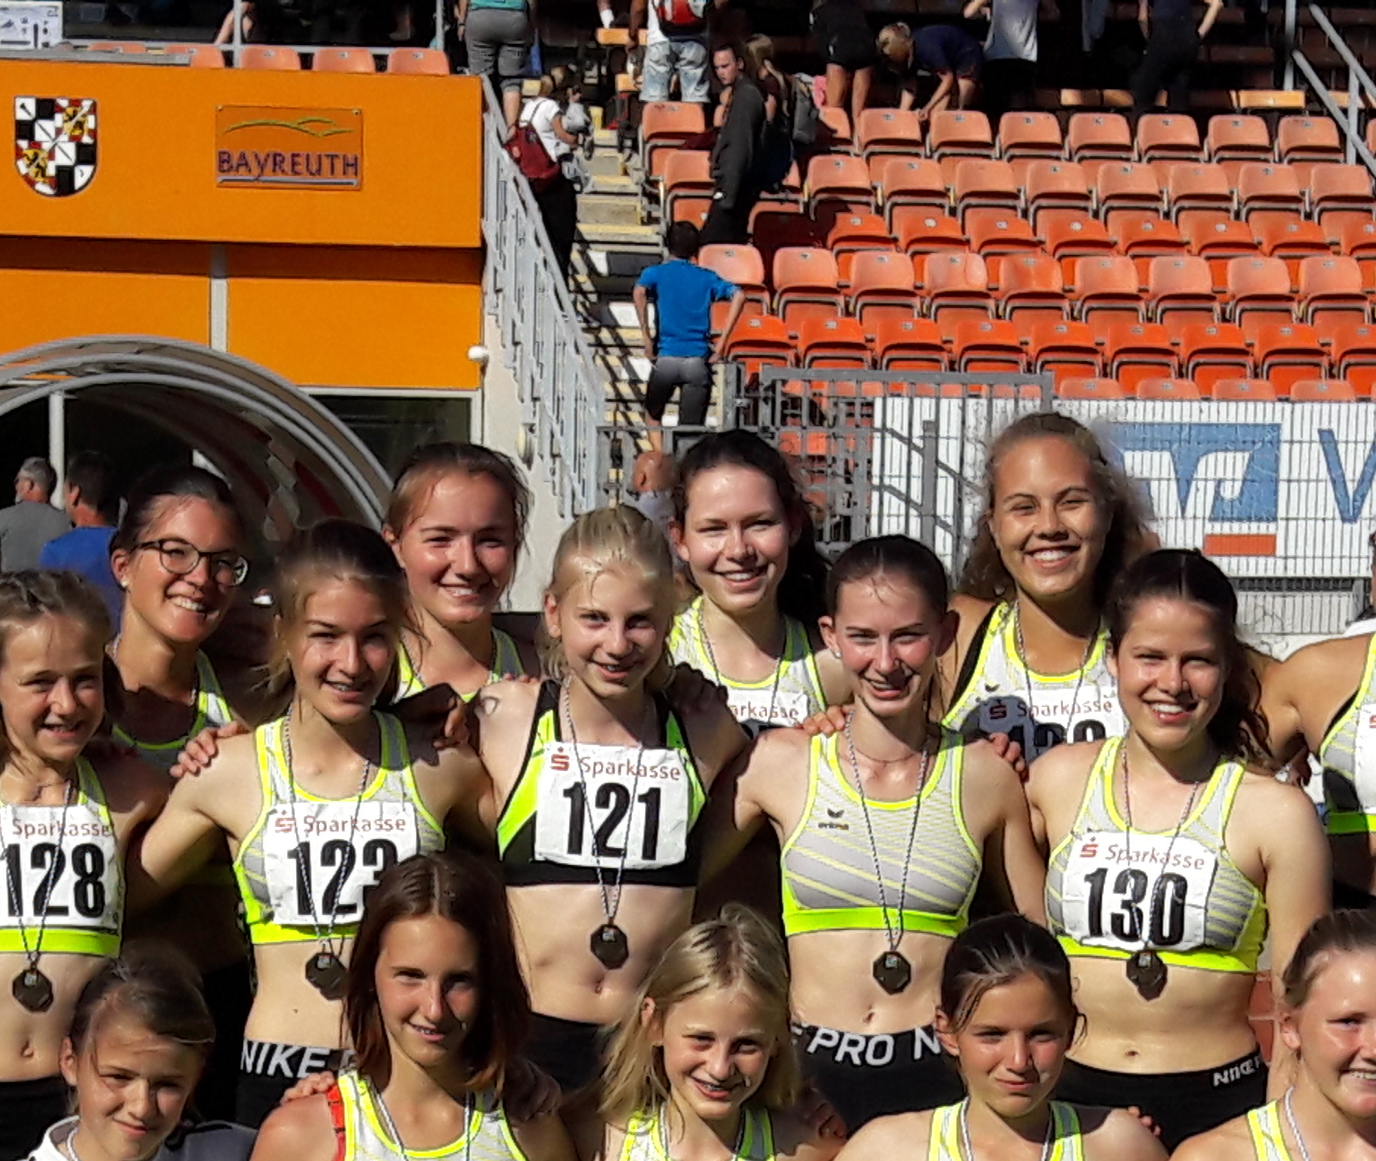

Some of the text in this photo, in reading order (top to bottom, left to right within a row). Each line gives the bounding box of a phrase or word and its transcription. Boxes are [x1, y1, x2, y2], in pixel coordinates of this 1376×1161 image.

[218, 151, 359, 179] BAYREUTH
[580, 756, 681, 781] Sparkasse
[12, 816, 113, 838] Sparkasse
[303, 815, 407, 837] Sparkasse
[563, 781, 661, 861] 121
[1105, 842, 1205, 871] Sparkasse
[0, 842, 106, 919] 128
[1083, 866, 1188, 946] 130
[240, 1039, 331, 1079] NIKE
[806, 1027, 895, 1066] PRO
